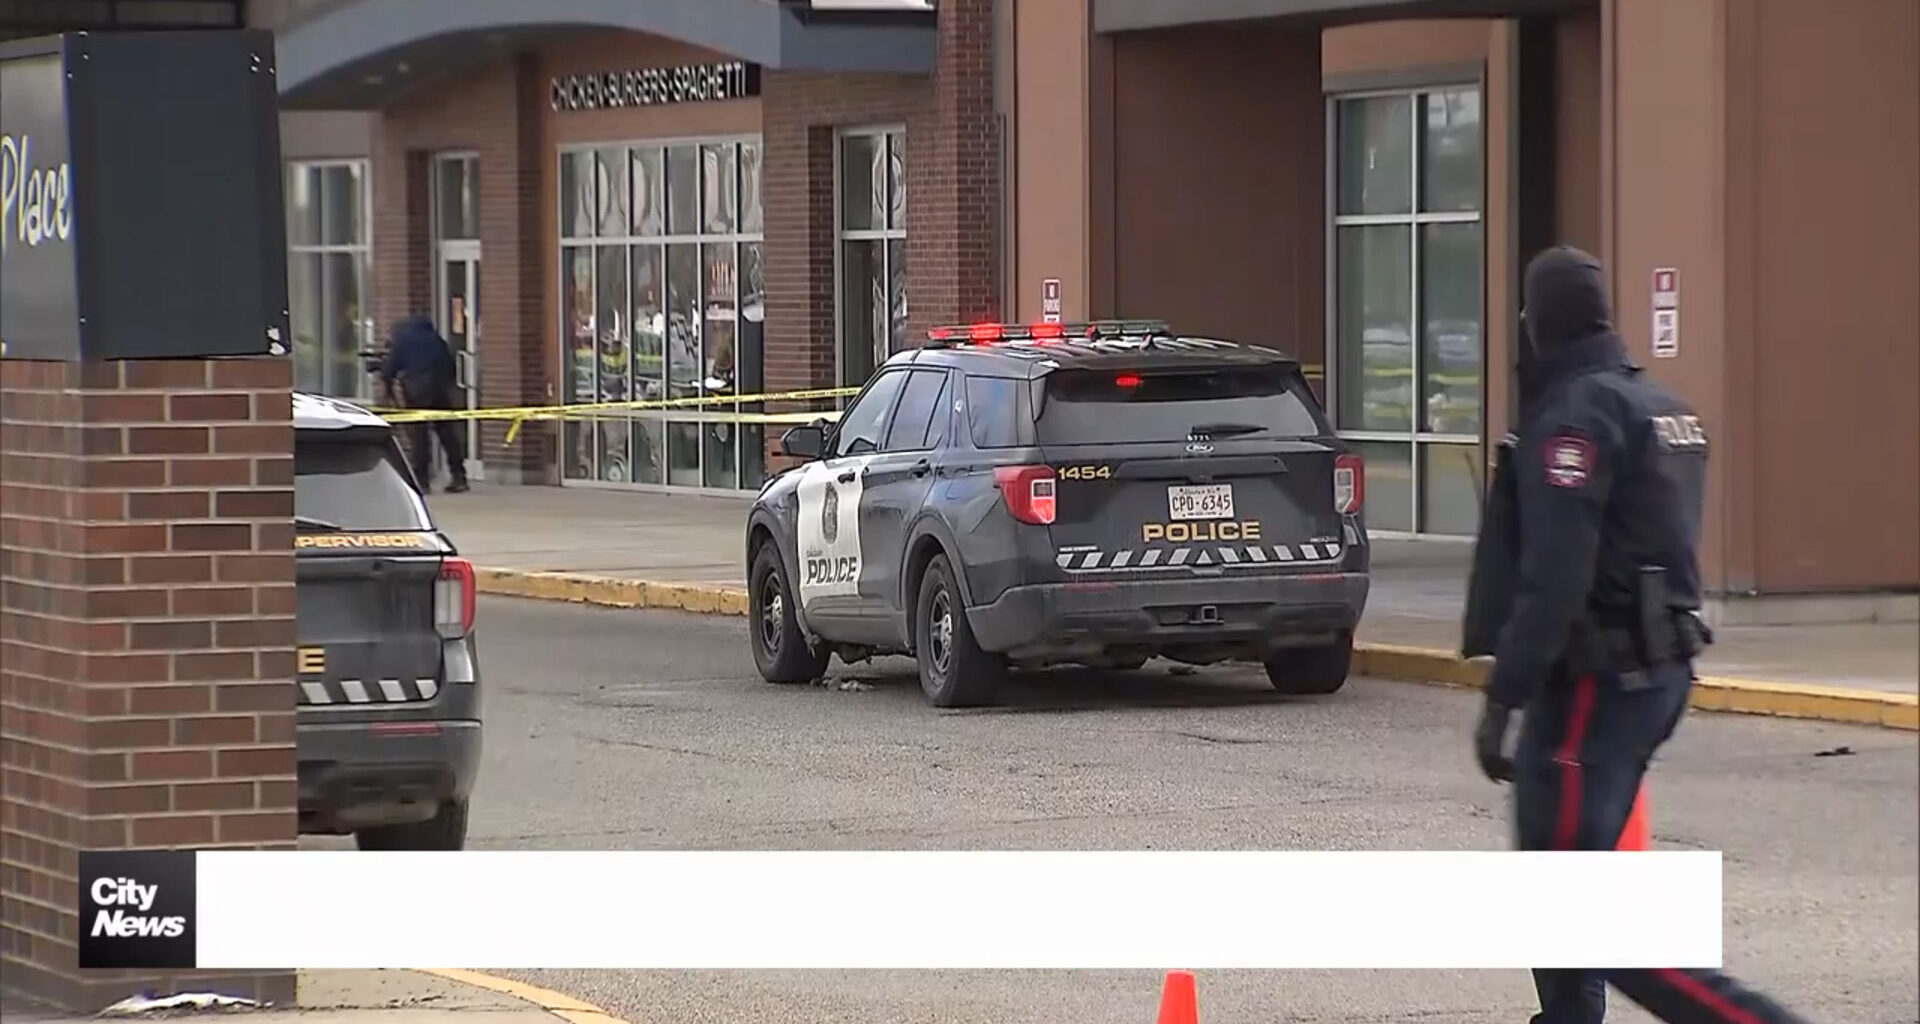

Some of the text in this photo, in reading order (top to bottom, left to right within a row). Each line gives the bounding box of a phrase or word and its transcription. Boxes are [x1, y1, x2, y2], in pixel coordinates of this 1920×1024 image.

[673, 61, 746, 101] SPAGHETTI
[0, 134, 71, 258] Place
[1058, 465, 1111, 480] 1454
[1143, 521, 1261, 542] POLICE
[806, 556, 857, 584] POLICE
